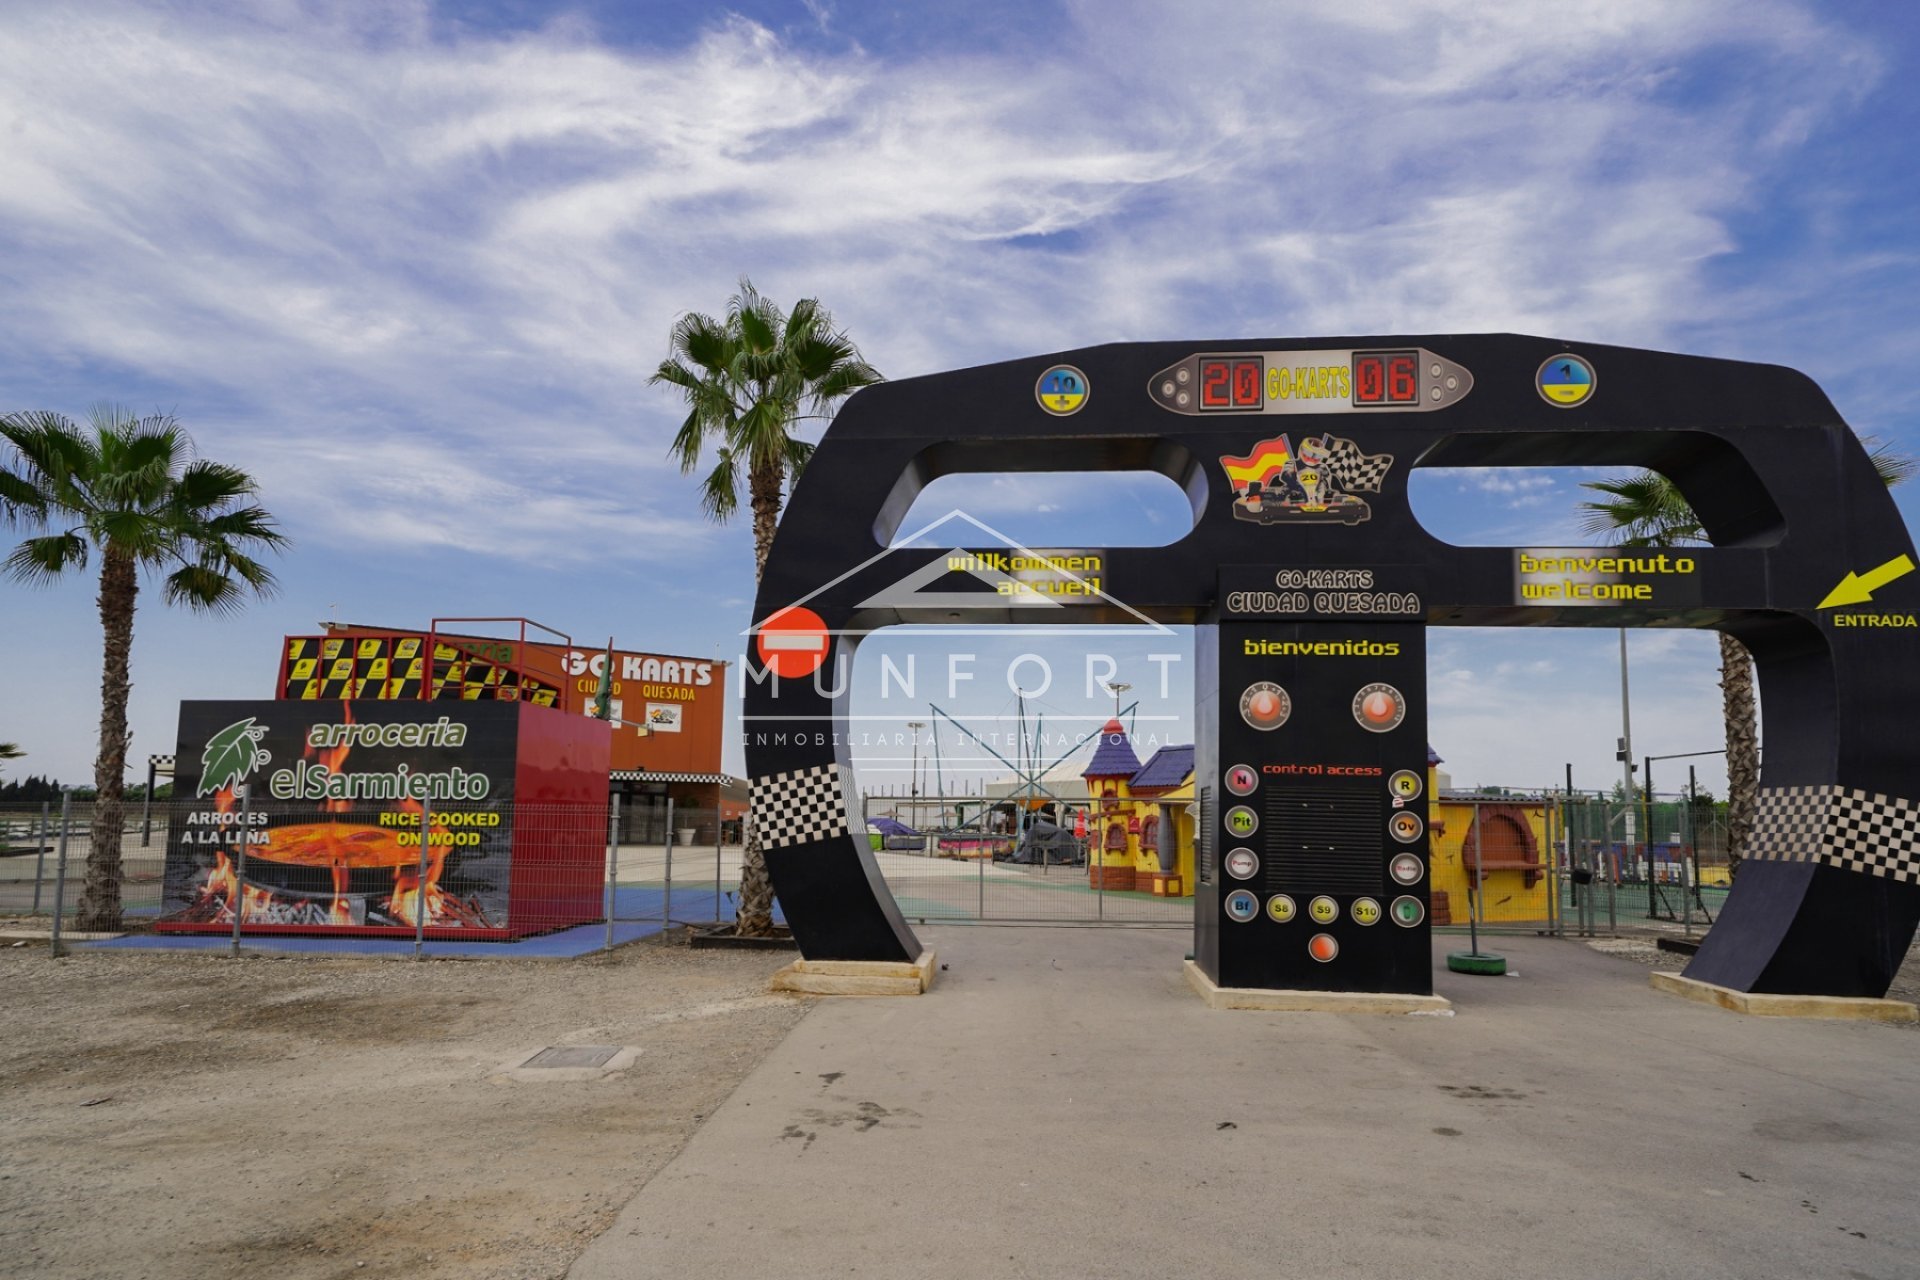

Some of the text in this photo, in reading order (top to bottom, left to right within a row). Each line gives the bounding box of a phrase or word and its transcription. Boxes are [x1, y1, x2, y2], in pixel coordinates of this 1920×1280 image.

[1558, 363, 1572, 381] 1
[1051, 376, 1076, 392] 10
[1203, 357, 1417, 406] 20 GO-KARTS 06
[947, 553, 1101, 572] willkommen
[1520, 553, 1695, 574] benvenuto
[1276, 569, 1374, 589] GO-KARTS
[997, 577, 1101, 597] accueil
[1520, 580, 1653, 600] welcome
[1227, 591, 1421, 615] CIUDAD QUESADA
[1833, 614, 1918, 628] ENTRADA
[1244, 639, 1400, 656] bienvenidos
[561, 651, 712, 686] GO KARTS
[577, 679, 696, 701] CIUD QUESADA
[308, 716, 467, 747] arroceria
[1262, 764, 1382, 776] control access
[1237, 775, 1247, 785] N
[1401, 781, 1410, 790] R
[186, 811, 269, 825] ARROCES
[379, 812, 500, 826] RICE COOKED
[1233, 816, 1251, 827] Pit
[1397, 822, 1415, 832] Ov
[180, 830, 193, 844] A
[198, 830, 220, 844] LA
[397, 832, 481, 846] ON WOOD
[1235, 901, 1249, 911] Bf
[1274, 904, 1289, 912] S8
[1316, 906, 1331, 914] S9
[1355, 907, 1377, 916] S10
